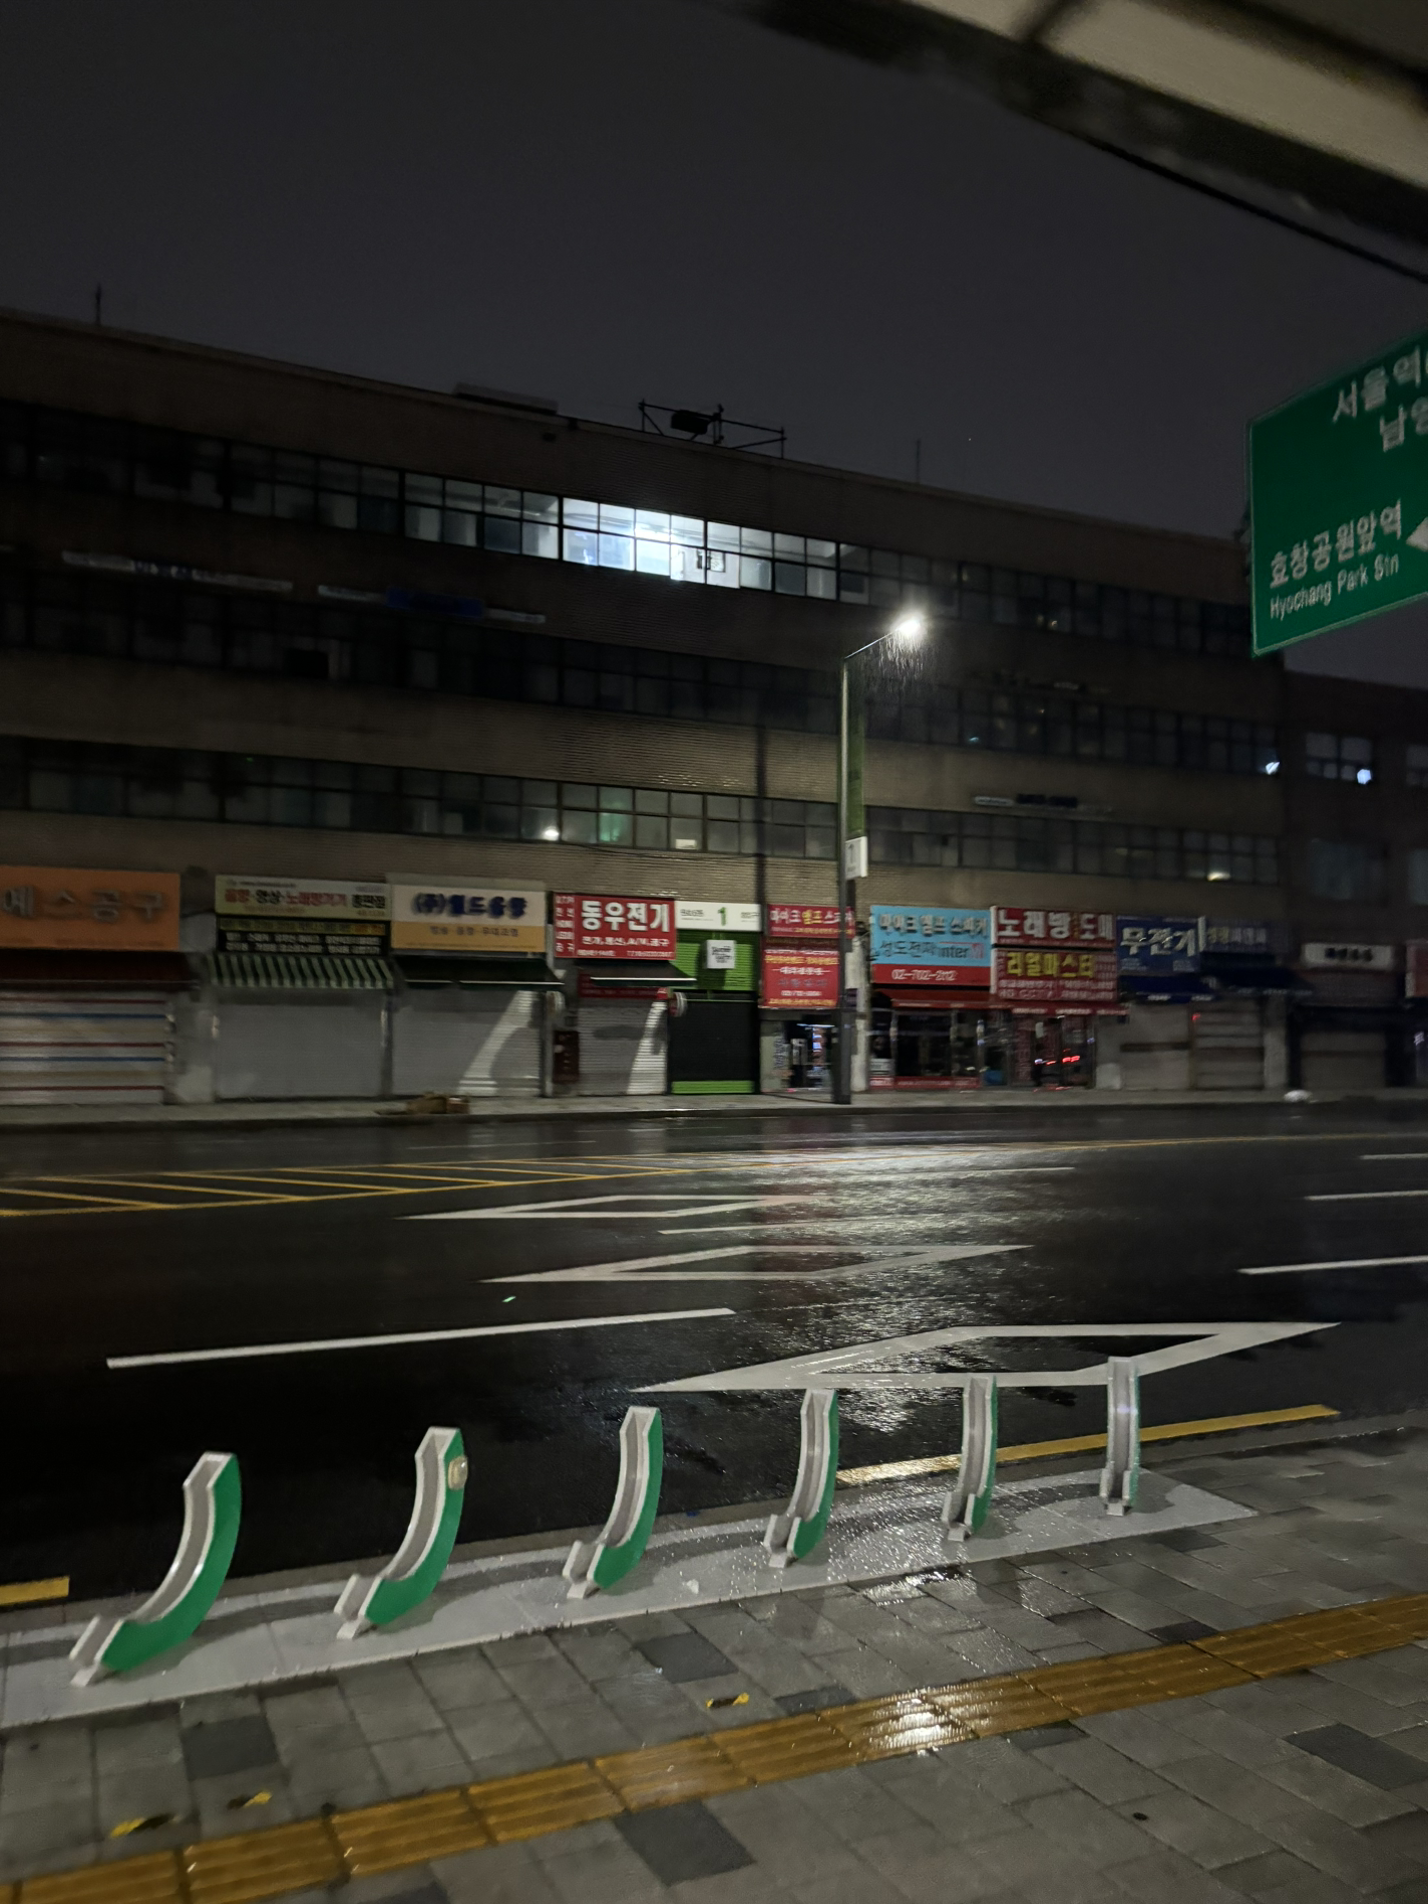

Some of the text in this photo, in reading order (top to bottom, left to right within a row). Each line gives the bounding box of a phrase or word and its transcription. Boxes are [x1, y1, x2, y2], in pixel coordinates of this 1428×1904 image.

[1331, 344, 1428, 424] 서울역
[1269, 552, 1400, 622] Hyochang Park Stn
[580, 899, 671, 933] 동우전기
[716, 906, 727, 927] 1
[998, 908, 1115, 942] 노래방 도매
[1120, 926, 1197, 957] 무전기
